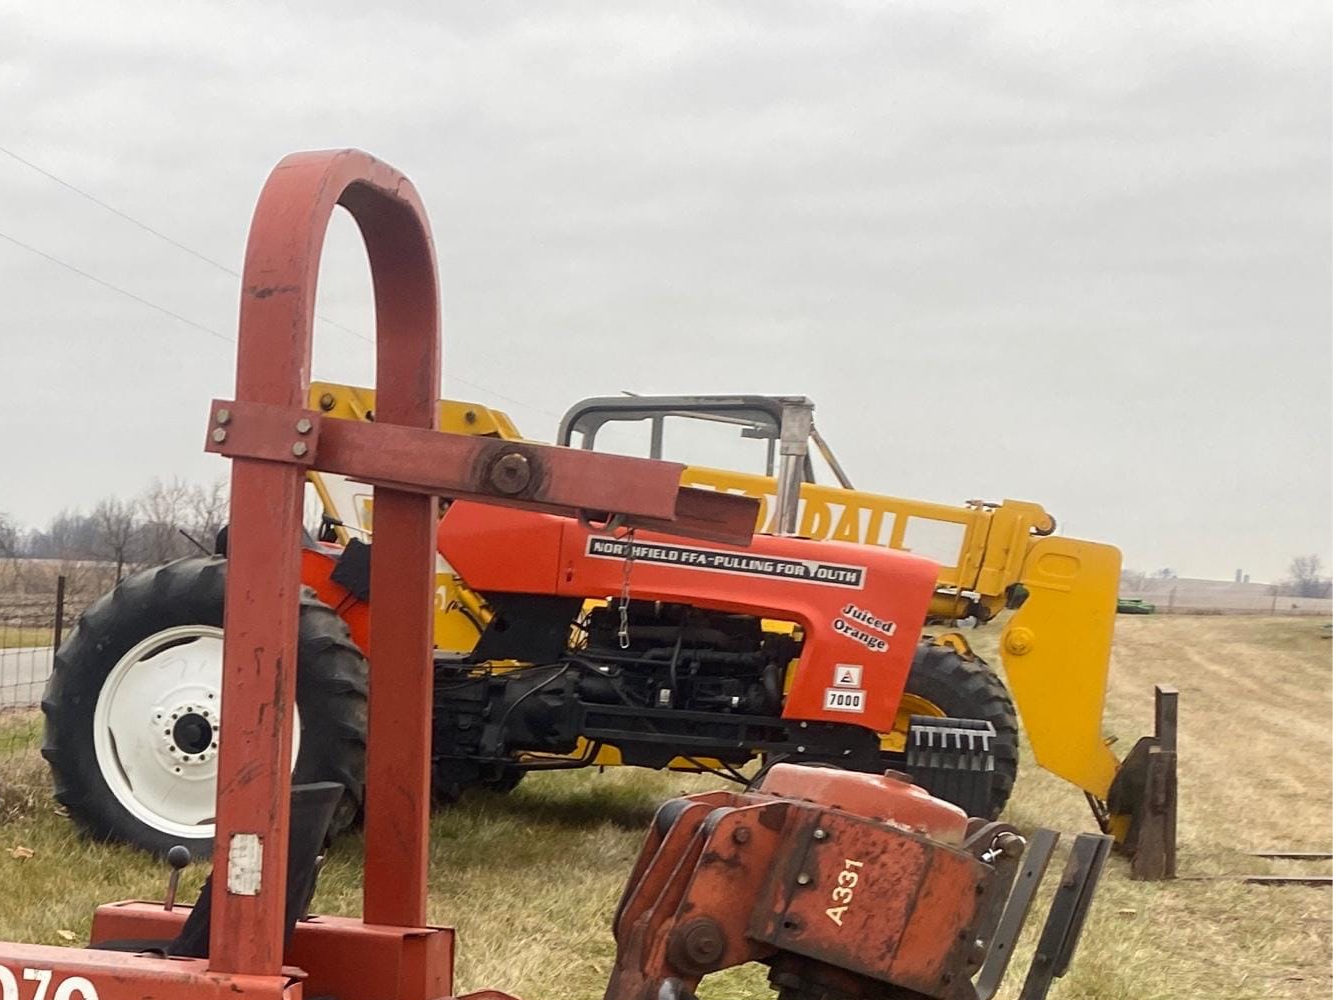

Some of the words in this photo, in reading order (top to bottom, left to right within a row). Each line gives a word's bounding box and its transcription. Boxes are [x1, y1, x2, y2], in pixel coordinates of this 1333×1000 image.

[681, 551, 773, 573] FFA-PULLING
[776, 563, 804, 576] FOR
[842, 605, 892, 633] Juiced
[833, 619, 885, 649] Orange
[829, 694, 860, 707] 7000
[826, 859, 864, 927] A331
